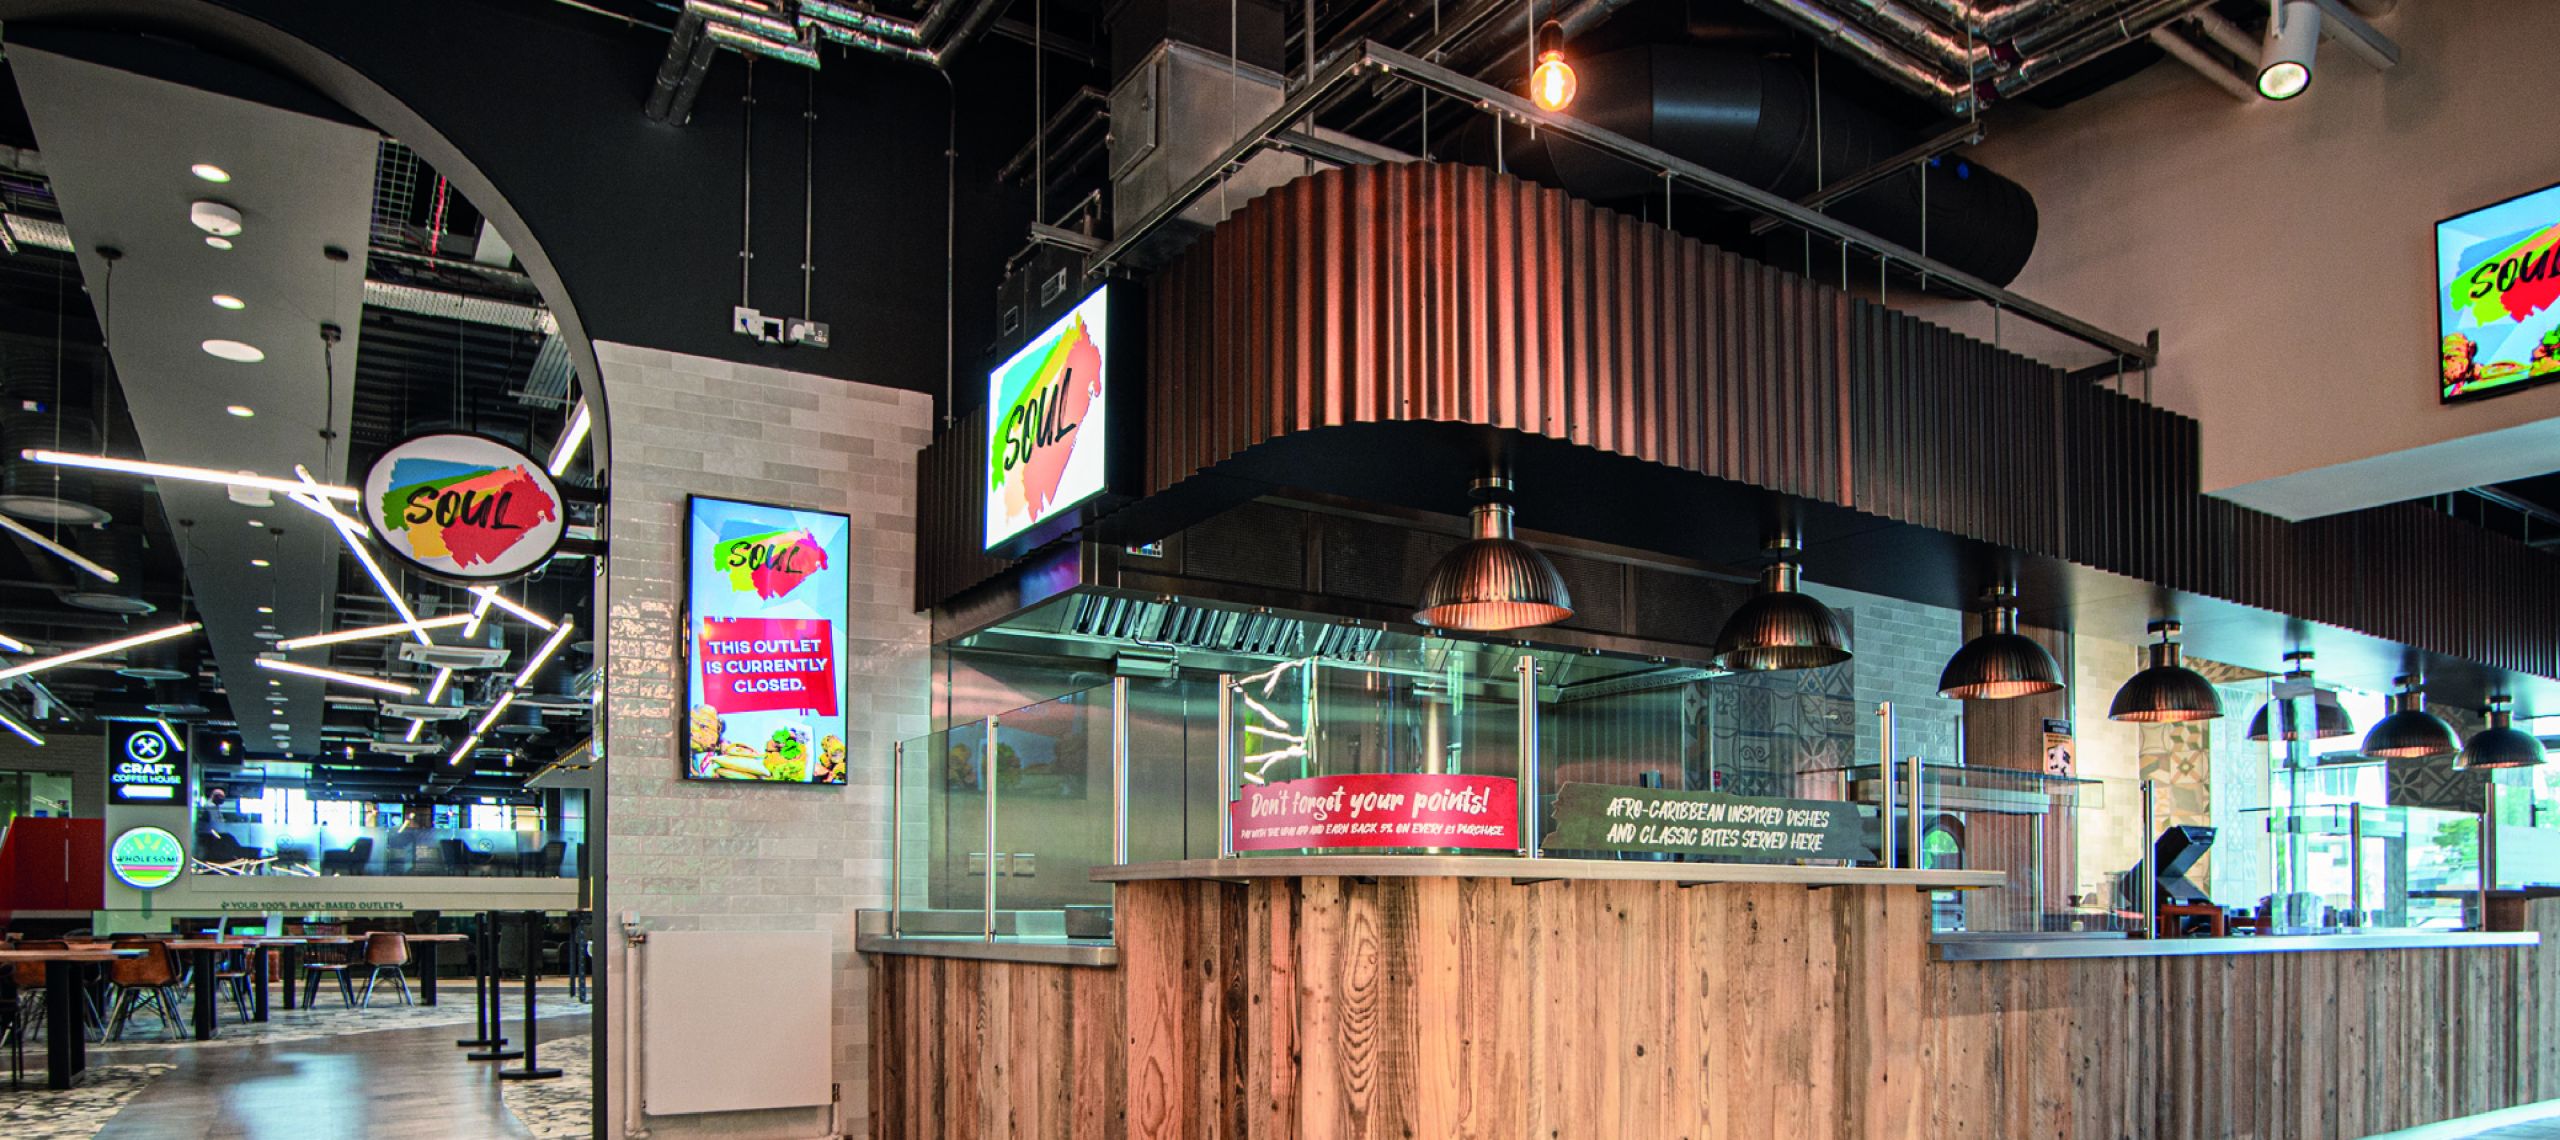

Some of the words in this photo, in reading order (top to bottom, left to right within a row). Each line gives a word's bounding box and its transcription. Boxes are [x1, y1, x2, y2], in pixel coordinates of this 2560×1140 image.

[1004, 367, 1076, 471] SOUL
[405, 486, 523, 530] SOUL
[729, 540, 803, 574] SOUL
[708, 639, 751, 655] THIS
[754, 638, 822, 653] OUTLET
[705, 659, 722, 675] IS
[726, 657, 828, 674] CURRENTLY
[734, 677, 807, 693] CLOSED.
[119, 762, 176, 775] CRAFT
[111, 773, 149, 784] COFFEE
[150, 775, 182, 785] HOUSE
[1250, 789, 1290, 818] Don't
[1292, 785, 1346, 821] forget
[1350, 791, 1405, 819] your
[1411, 785, 1491, 819] points!
[1606, 797, 1726, 823] AFRO-CARIBBEAN
[1727, 805, 1784, 828] INSPIRED
[1786, 808, 1831, 828] DISHES
[1326, 823, 1350, 835] EARN
[1350, 822, 1378, 834] BACK
[1380, 822, 1393, 833] 5%
[1396, 822, 1411, 834] ON
[1412, 822, 1442, 835] EVERY
[1606, 822, 1637, 844] AND
[1639, 825, 1698, 846] CLASSIC
[1700, 827, 1740, 848] BITES
[1741, 830, 1788, 852] SERVED
[1790, 832, 1825, 853] HERE
[231, 901, 258, 910] YOUR
[261, 901, 288, 910] 100%
[290, 901, 357, 910] PLANT-BASED
[358, 901, 394, 910] OUTLET
